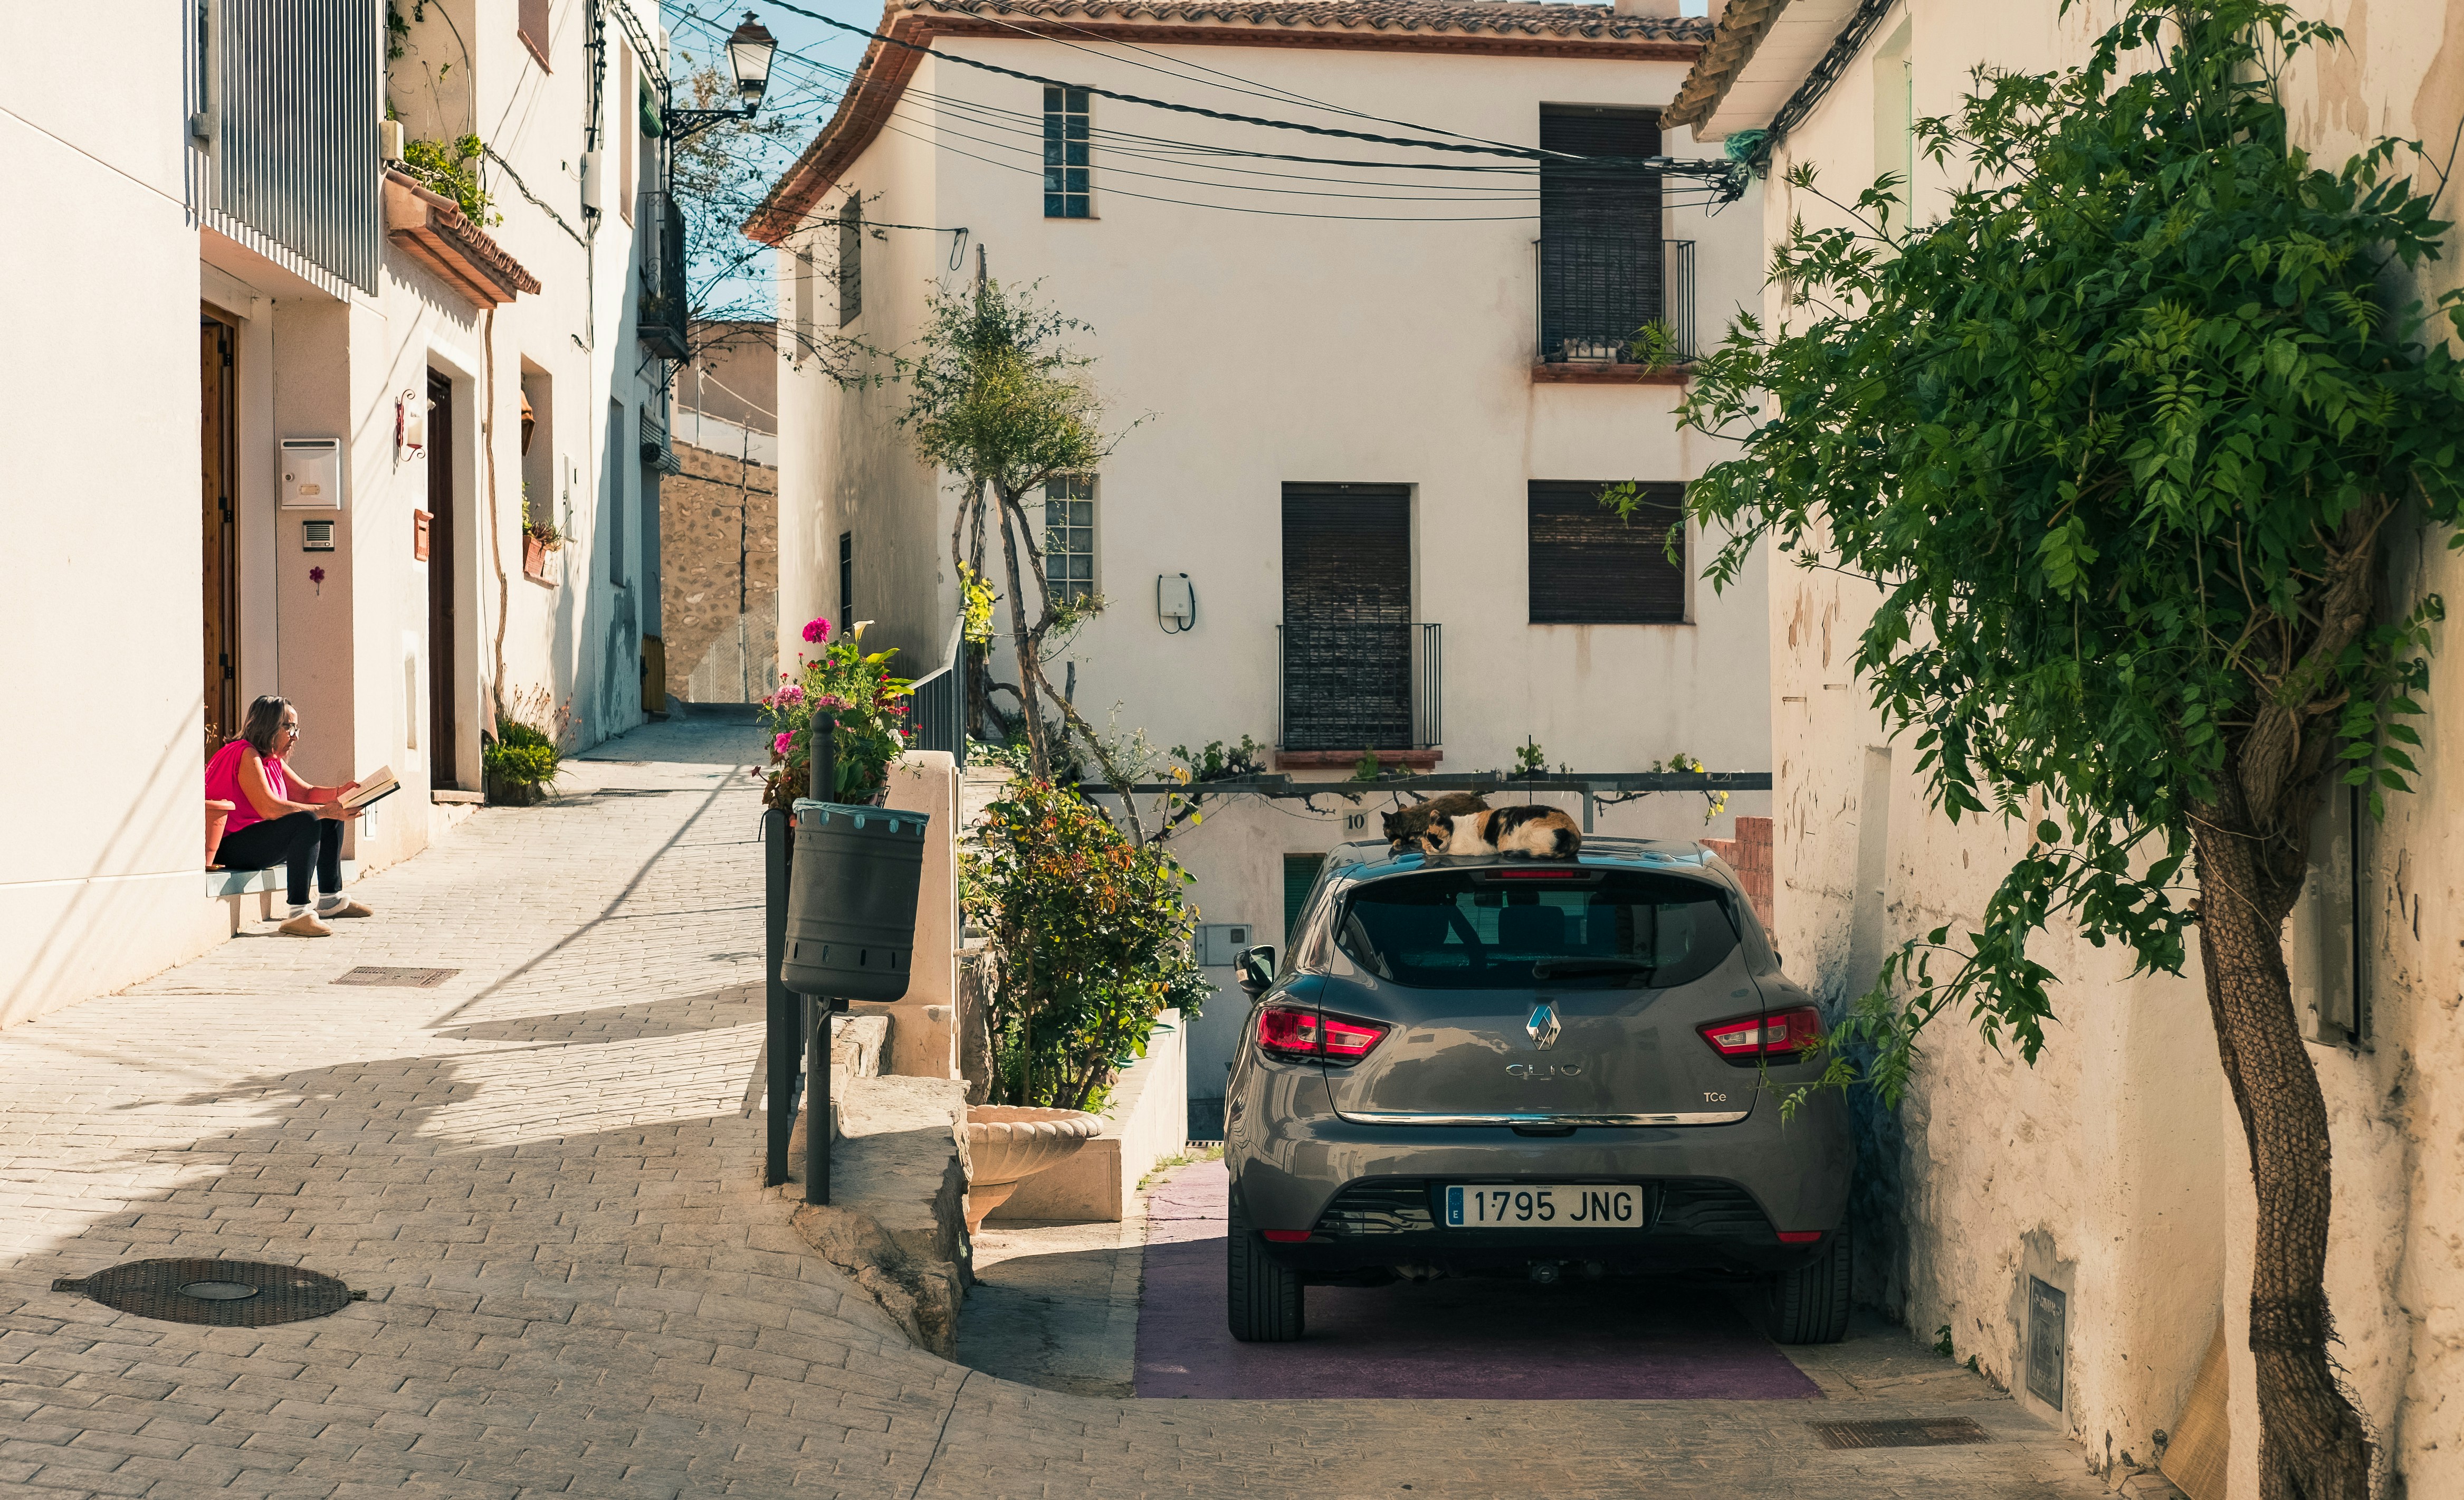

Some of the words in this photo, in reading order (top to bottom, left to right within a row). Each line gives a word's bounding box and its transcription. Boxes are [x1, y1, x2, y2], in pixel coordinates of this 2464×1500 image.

[1348, 814, 1364, 829] 10
[1506, 1064, 1582, 1076] CLIO
[1704, 1092, 1726, 1102] TCe
[1475, 1191, 1555, 1221] 1795
[1570, 1191, 1632, 1221] JNG
